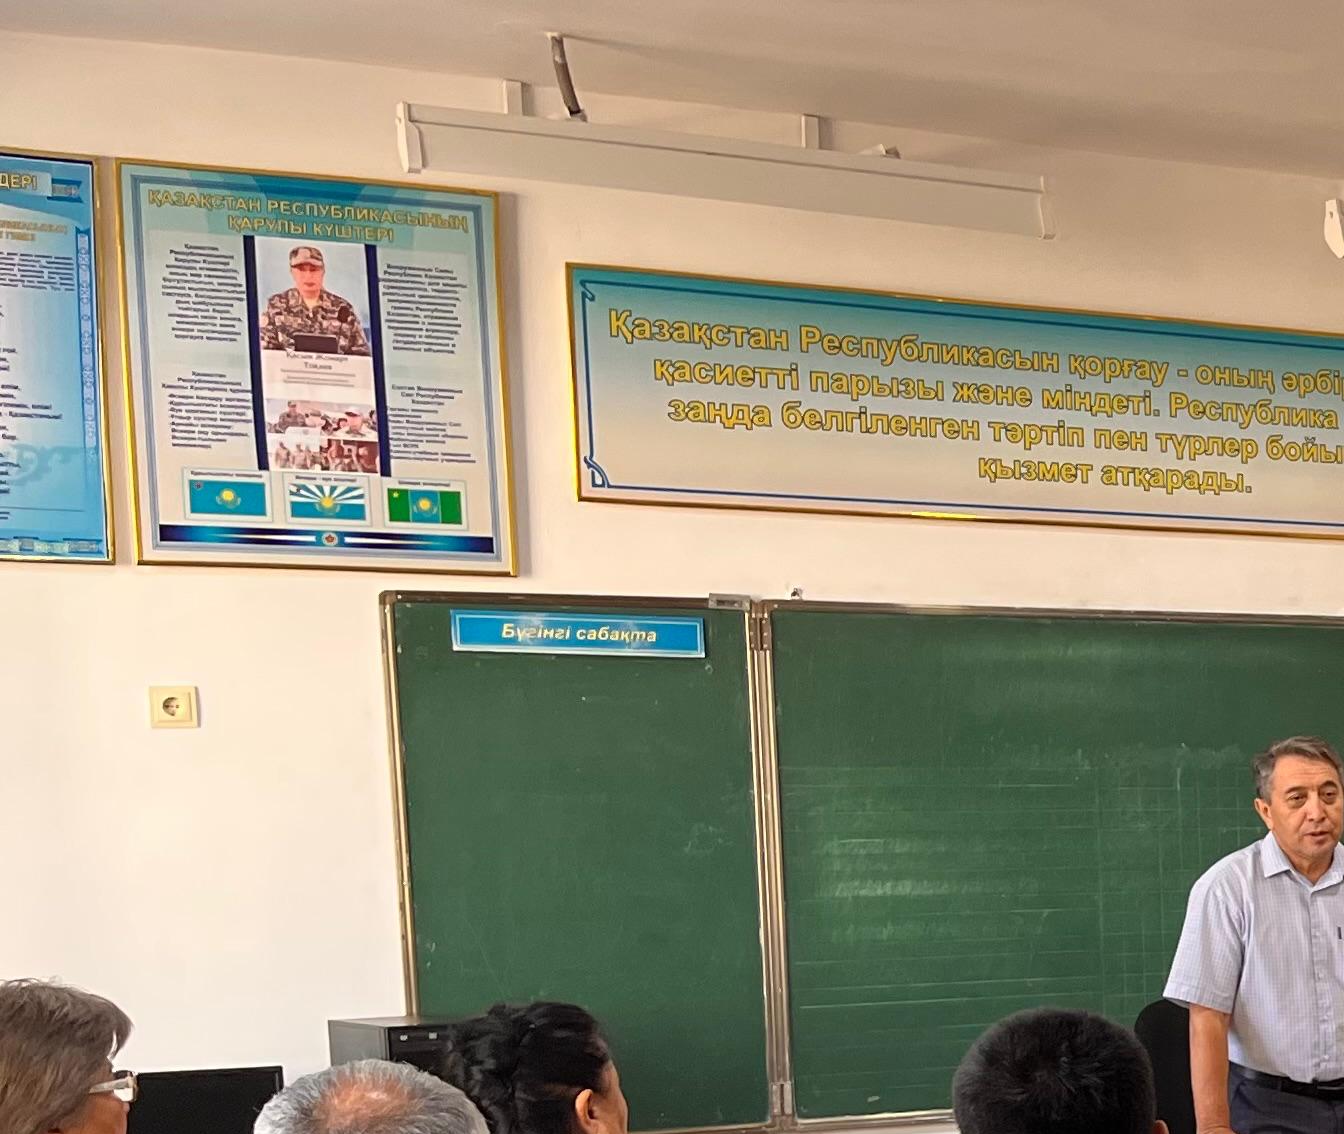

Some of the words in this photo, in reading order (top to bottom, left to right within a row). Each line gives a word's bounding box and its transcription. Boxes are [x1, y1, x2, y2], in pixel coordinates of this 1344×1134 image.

[148, 189, 261, 213] ҚАЗАҚСТАН
[267, 200, 468, 233] РЕСПУБЛИКАСЫНЫҢ
[227, 215, 307, 236] ҚАРУЛЫ
[312, 222, 394, 242] КҮШТЕРІ
[609, 308, 789, 351] Қазақстан
[799, 325, 1059, 373] Республикасын
[1069, 353, 1169, 387] қорғау
[1195, 364, 1274, 394] оның
[653, 358, 799, 390] қасиетті
[810, 370, 945, 401] парызы
[953, 382, 1032, 407] және
[1042, 384, 1160, 417] міндеті.
[1169, 392, 1338, 430] Республика
[668, 399, 772, 430] заңда
[781, 401, 980, 440] белгіленген
[989, 420, 1084, 450] тәртіп
[1094, 428, 1148, 452] пен
[1157, 433, 1258, 464] түрлер
[978, 457, 1092, 484] қызмет
[1101, 464, 1252, 495] атқарады.
[501, 622, 571, 643] Бүгінгі
[576, 625, 658, 646] сабақта
